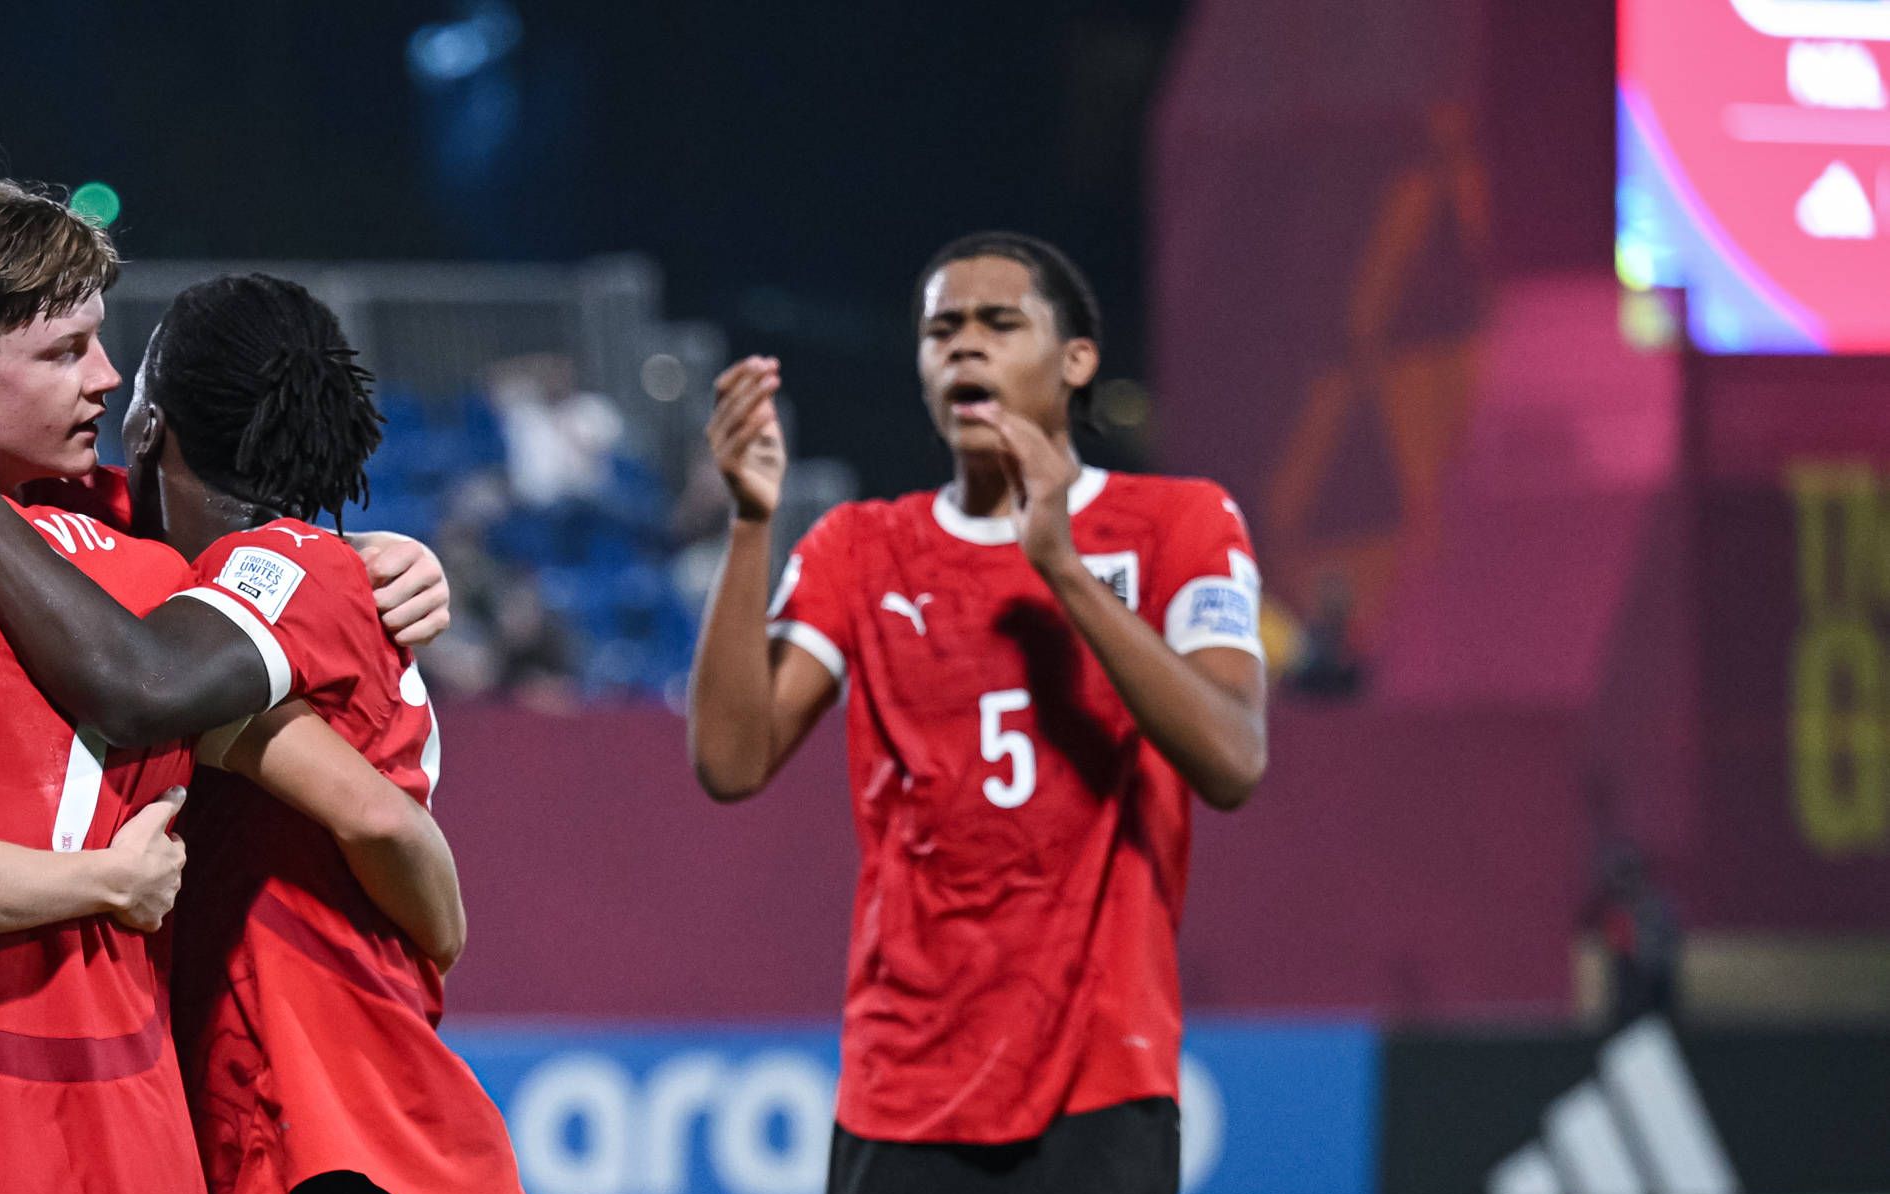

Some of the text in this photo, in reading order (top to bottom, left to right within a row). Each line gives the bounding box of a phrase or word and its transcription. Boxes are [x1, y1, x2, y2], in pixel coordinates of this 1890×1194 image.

[239, 561, 281, 586] UNITES
[244, 554, 285, 577] FOOTBALL
[979, 688, 1036, 809] 5
